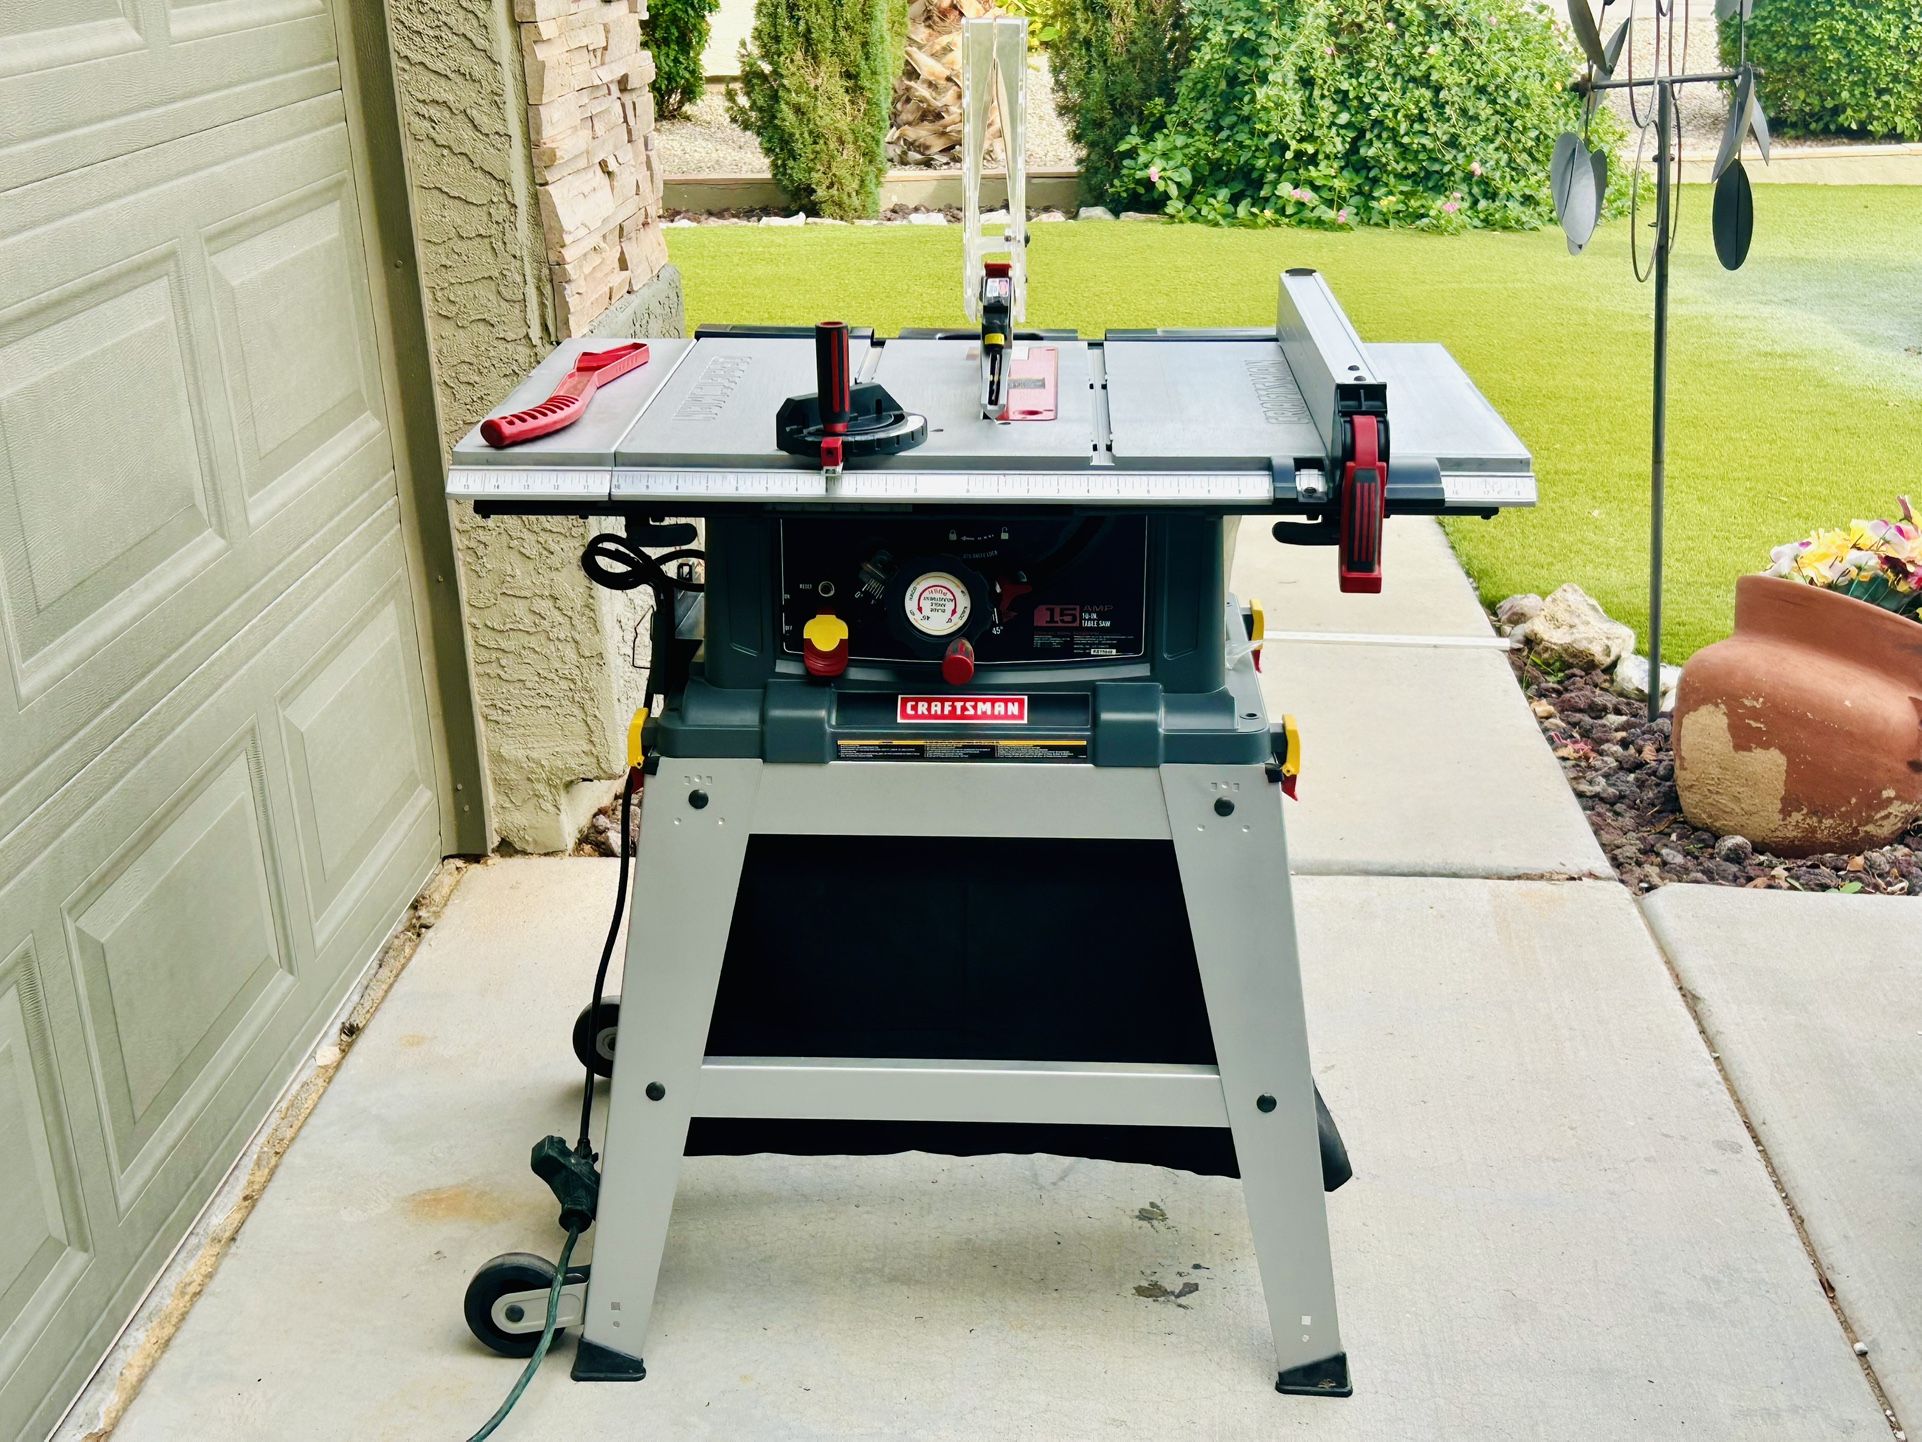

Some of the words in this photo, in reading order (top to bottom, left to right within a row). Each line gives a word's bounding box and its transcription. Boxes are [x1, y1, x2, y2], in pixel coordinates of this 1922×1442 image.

[1244, 359, 1312, 425] CRAFTSMAN
[1045, 607, 1078, 625] 15
[906, 701, 1020, 716] CRAFTSMAN
